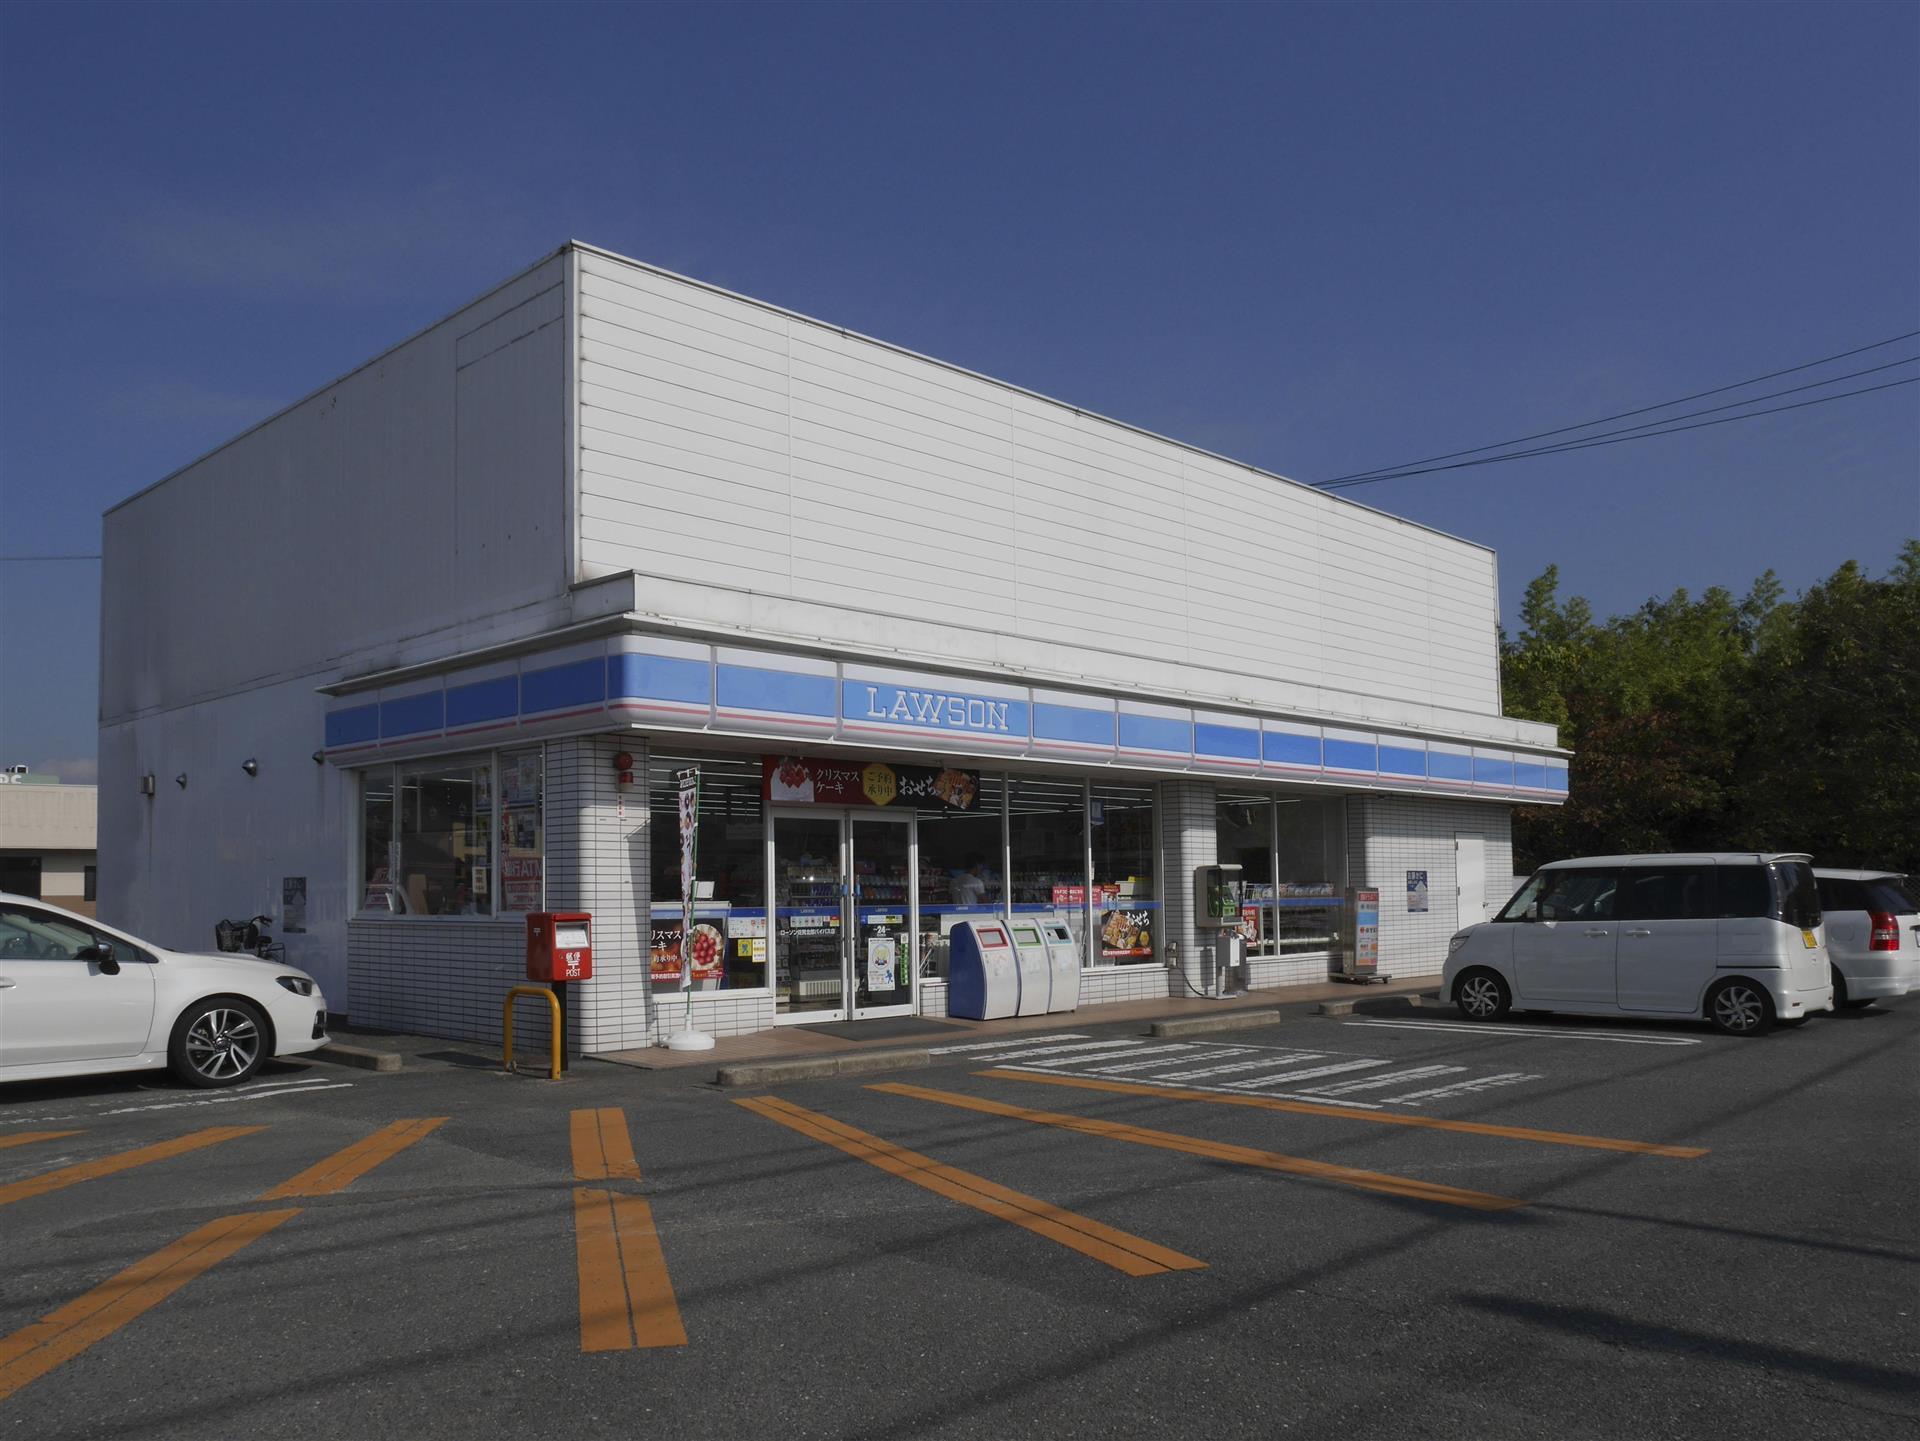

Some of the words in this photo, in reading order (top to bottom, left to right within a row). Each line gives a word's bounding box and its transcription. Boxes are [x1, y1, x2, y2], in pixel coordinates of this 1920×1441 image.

[866, 687, 1009, 730] LAWSON
[816, 769, 860, 782] クリスマス
[867, 771, 893, 784] ご予約
[816, 781, 845, 795] ケーキ
[867, 783, 893, 798] 承り中
[899, 776, 939, 797] おせち
[1126, 909, 1150, 927] おせち
[566, 951, 581, 961] 郵便
[566, 968, 581, 977] POST
